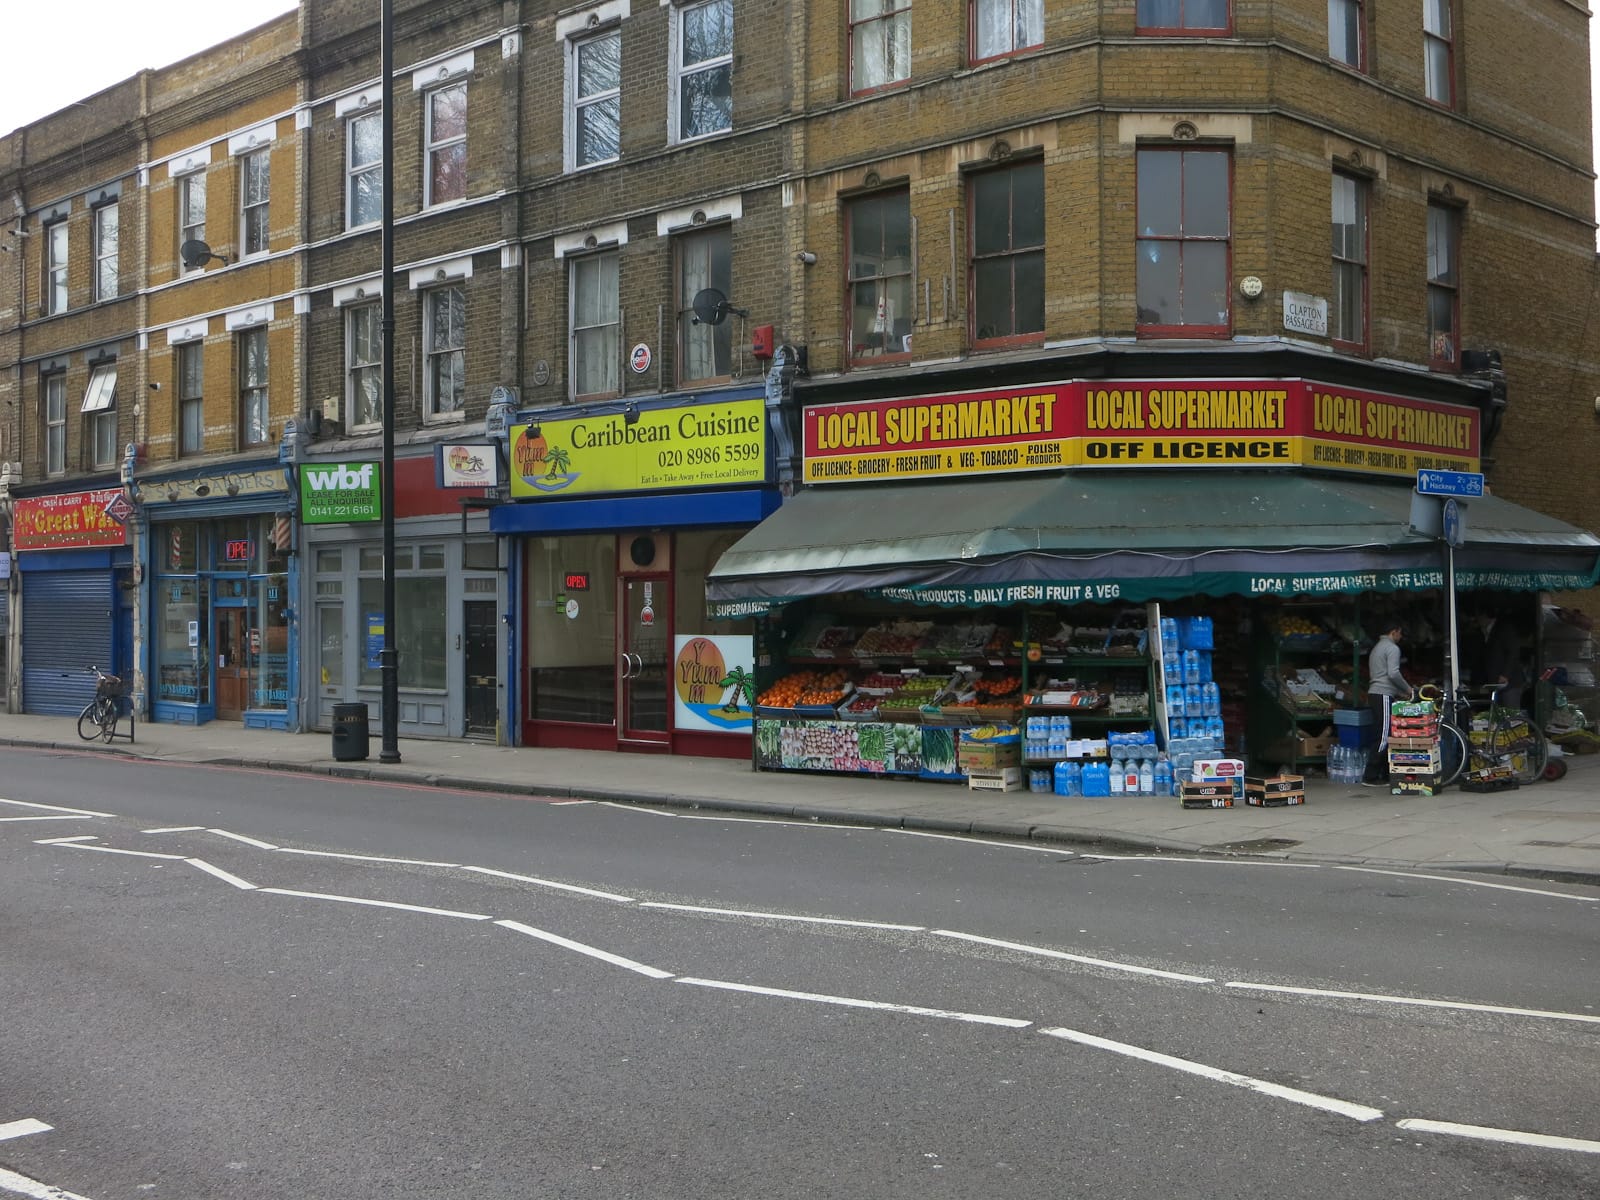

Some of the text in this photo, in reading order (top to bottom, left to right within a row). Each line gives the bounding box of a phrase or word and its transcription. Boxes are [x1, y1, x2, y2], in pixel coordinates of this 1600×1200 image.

[1289, 304, 1322, 319] CLAPTON
[1286, 316, 1313, 329] PASSAGE
[1086, 389, 1287, 430] LOCAL SUPERMARKET
[571, 410, 760, 449] Caribbean Cuisine
[817, 393, 1057, 449] LOCAL SUPERMARKET
[1313, 393, 1472, 450] LOCAL SUPERMARKET
[658, 442, 760, 467] 020 8986 5599
[1028, 443, 1060, 455] POLISH
[1086, 441, 1289, 459] OFF LICENCE
[812, 448, 1019, 477] OFF LICENCE GROCERY FRESH FRUIT & VEG TOBACCO
[1026, 453, 1062, 465] PRODUCTS
[306, 463, 373, 491] wbf
[641, 475, 651, 484] Eat
[664, 473, 678, 482] Take
[679, 472, 695, 483] Away
[700, 471, 714, 480] Free
[715, 469, 731, 478] Local
[733, 467, 759, 478] Delivery
[1430, 474, 1443, 483] City
[307, 489, 375, 499] LEASE FOR SALE
[1430, 482, 1456, 492] Hackney
[310, 505, 373, 516] 0141 221 6161
[328, 498, 373, 506] ENQUIRIES
[35, 509, 80, 533] Great
[566, 575, 586, 588] OPEN
[1293, 575, 1377, 592] SUPERMARKET
[1389, 574, 1411, 588] OFF
[1414, 572, 1444, 587] LICEN
[915, 590, 966, 603] PRODUCTS
[974, 589, 1004, 602] DAILY
[1007, 586, 1043, 601] FRESH
[1046, 586, 1080, 600] FRUIT
[1084, 585, 1094, 599] &
[1097, 584, 1120, 598] VEG
[716, 601, 771, 618] SUPERMARKE
